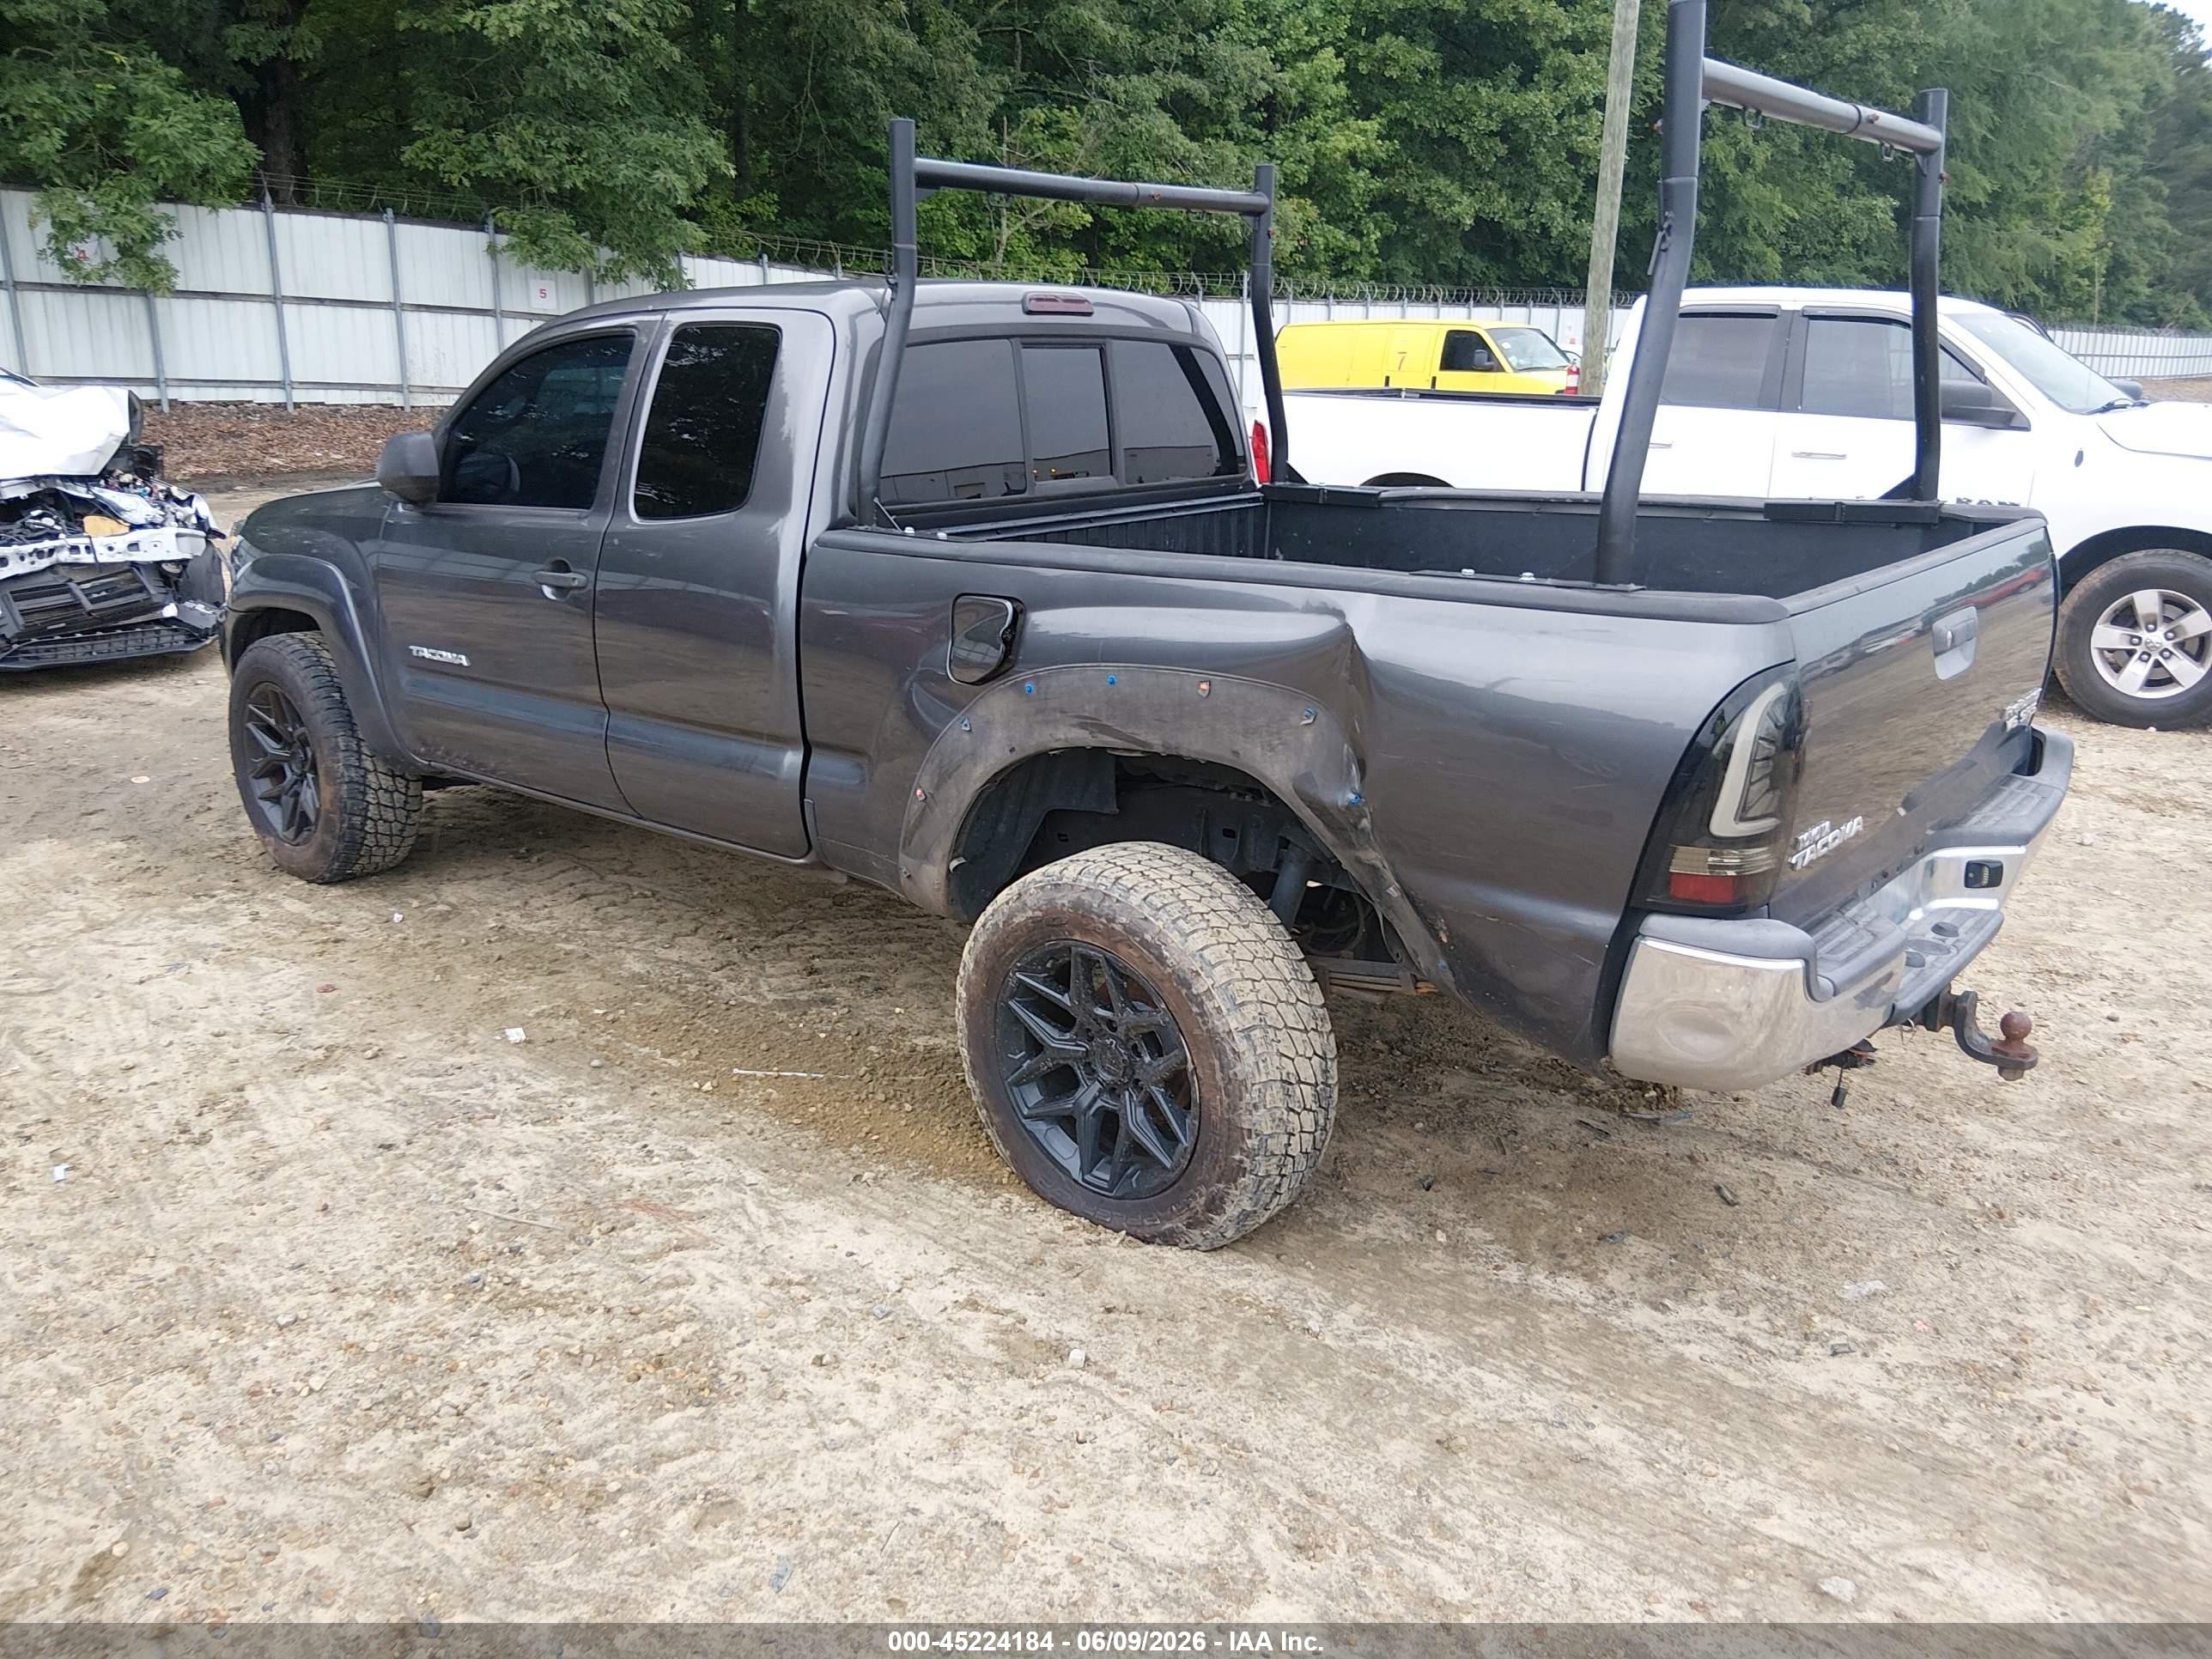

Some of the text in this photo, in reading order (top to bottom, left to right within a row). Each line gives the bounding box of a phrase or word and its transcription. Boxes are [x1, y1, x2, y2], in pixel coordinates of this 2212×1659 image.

[539, 288, 547, 300] 5
[408, 645, 471, 666] TACOMA
[1787, 816, 1863, 871] TACOMA
